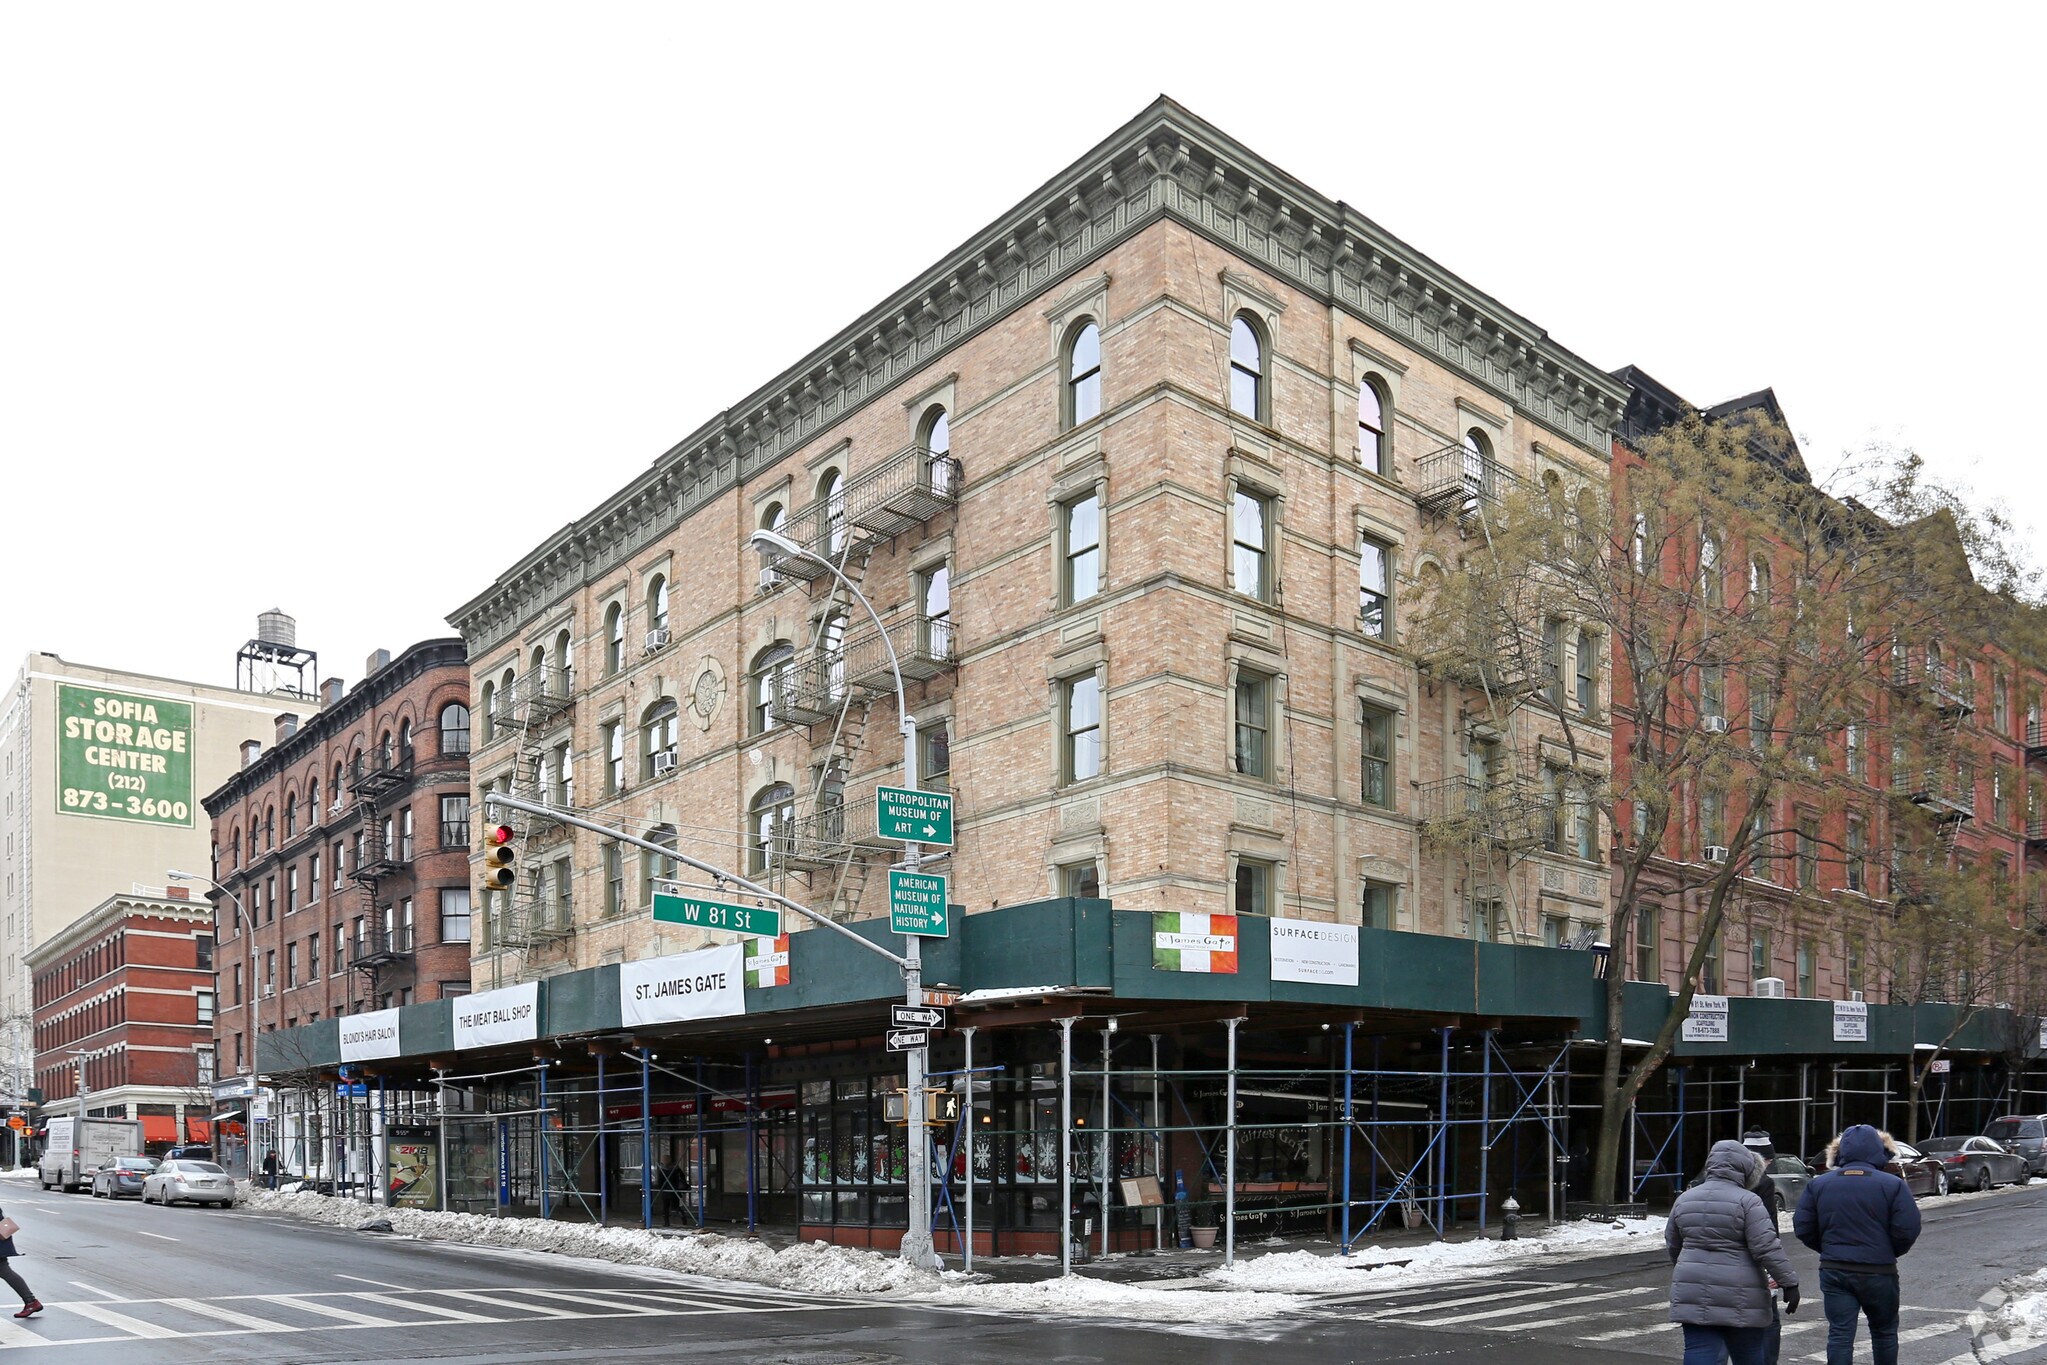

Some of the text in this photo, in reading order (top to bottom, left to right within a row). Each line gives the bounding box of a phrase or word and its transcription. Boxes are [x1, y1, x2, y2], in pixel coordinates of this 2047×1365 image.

[94, 697, 158, 724] SOFIA
[65, 716, 186, 753] STORAGE
[85, 746, 167, 774] CENTER
[108, 772, 146, 793] (212)
[881, 791, 949, 810] METROPOLITAN
[888, 805, 942, 821] MUSEUM OF
[894, 822, 912, 833] ART
[898, 877, 938, 891] AMERICAN
[895, 890, 941, 904] MUSEUM OF
[684, 903, 751, 929] W 81 St
[894, 903, 929, 916] NATURAL
[896, 916, 928, 929] HISTORY
[1170, 935, 1201, 944] James
[1203, 936, 1231, 949] Gate
[635, 973, 726, 1001] ST. JAMES GATE
[922, 991, 930, 1004] W
[934, 992, 943, 1005] 81
[459, 1004, 532, 1029] THE MEAT BALL SHOP
[900, 1012, 937, 1022] ONE WAY
[343, 1026, 396, 1045] BLONDI'S HAIR SALON
[893, 1034, 923, 1044] ONE WAY
[1315, 1101, 1338, 1112] Jams
[1339, 1103, 1359, 1116] Gte
[1249, 1212, 1267, 1223] Gate
